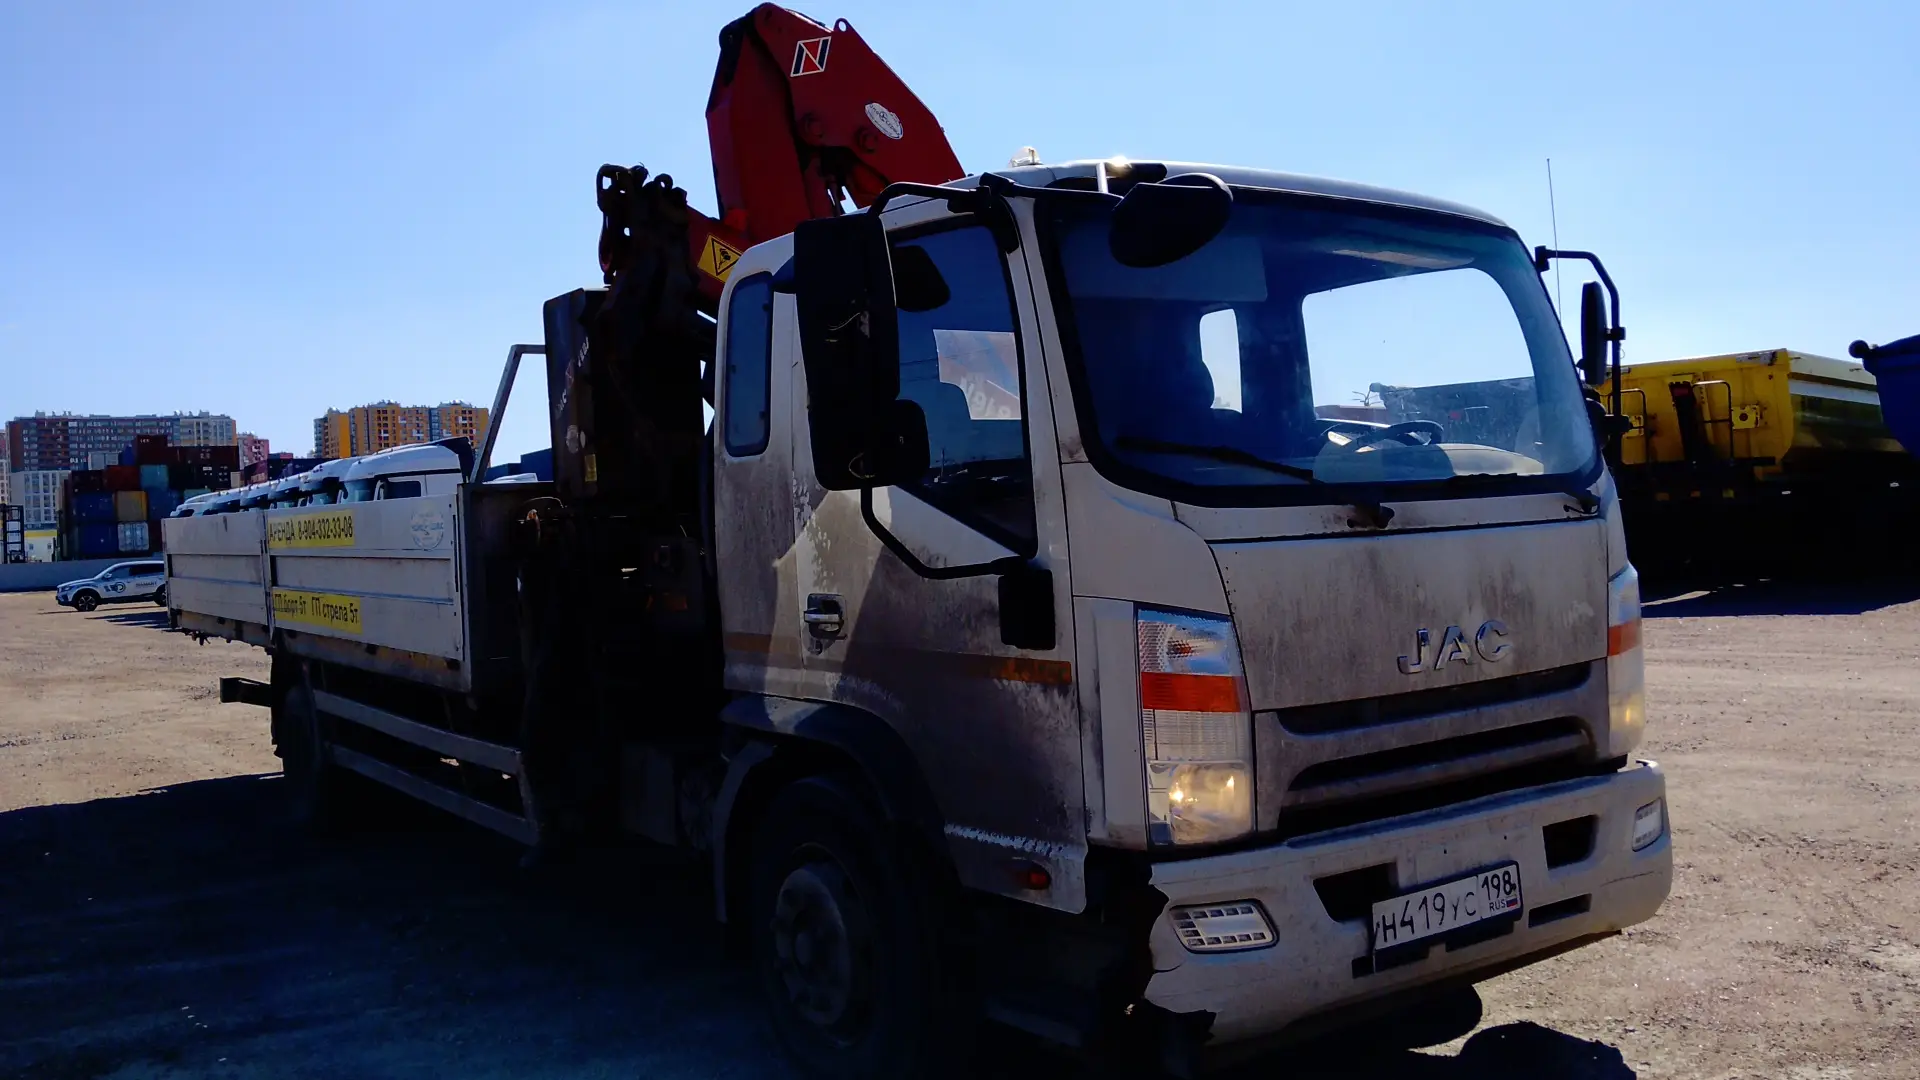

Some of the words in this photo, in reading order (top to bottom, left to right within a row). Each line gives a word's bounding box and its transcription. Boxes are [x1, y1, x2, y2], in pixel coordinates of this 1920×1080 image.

[269, 518, 296, 545] АРЕНДА
[322, 603, 348, 624] стрела
[1397, 619, 1512, 674] JAC
[1481, 870, 1514, 900] 198
[1489, 900, 1506, 912] RUS
